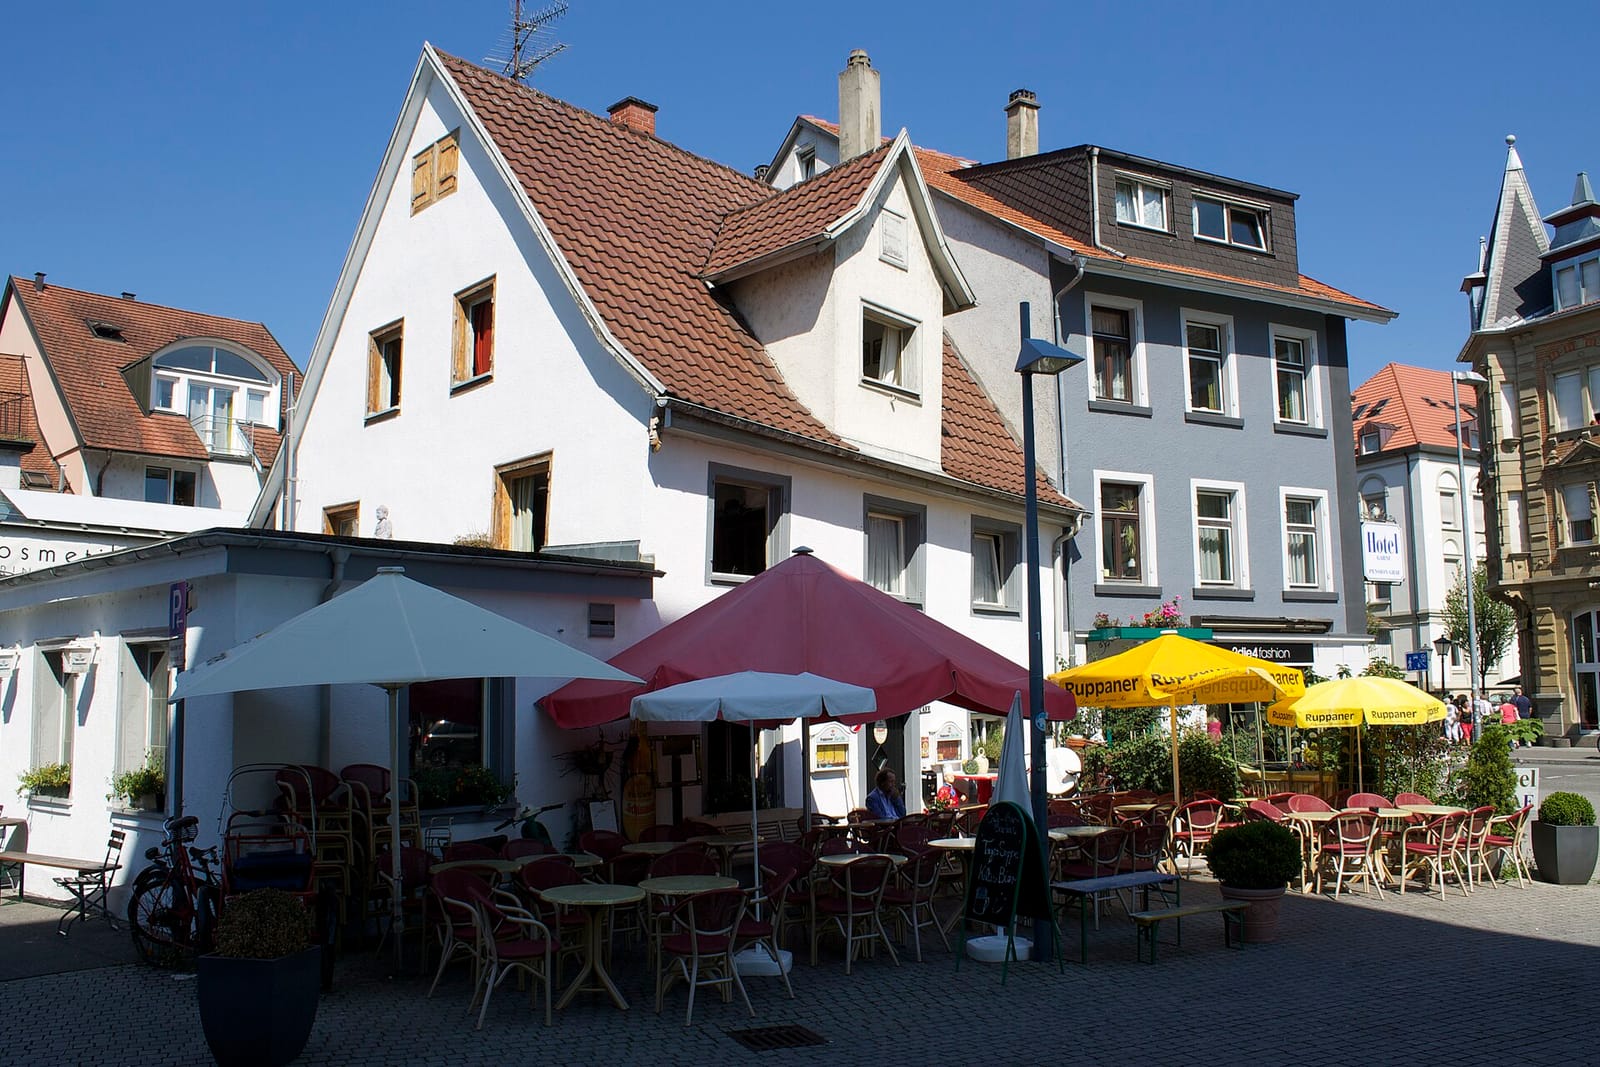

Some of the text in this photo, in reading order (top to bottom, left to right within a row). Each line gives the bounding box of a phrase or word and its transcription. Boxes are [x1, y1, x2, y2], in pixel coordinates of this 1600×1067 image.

[1368, 532, 1399, 554] Hotel
[0, 544, 115, 562] osmet
[172, 589, 182, 630] P
[1065, 677, 1139, 697] Ruppaner
[1150, 668, 1228, 687] Rupp
[1305, 712, 1355, 723] Ruppaner
[1371, 710, 1417, 720] Ruppaner
[1519, 769, 1536, 788] el
